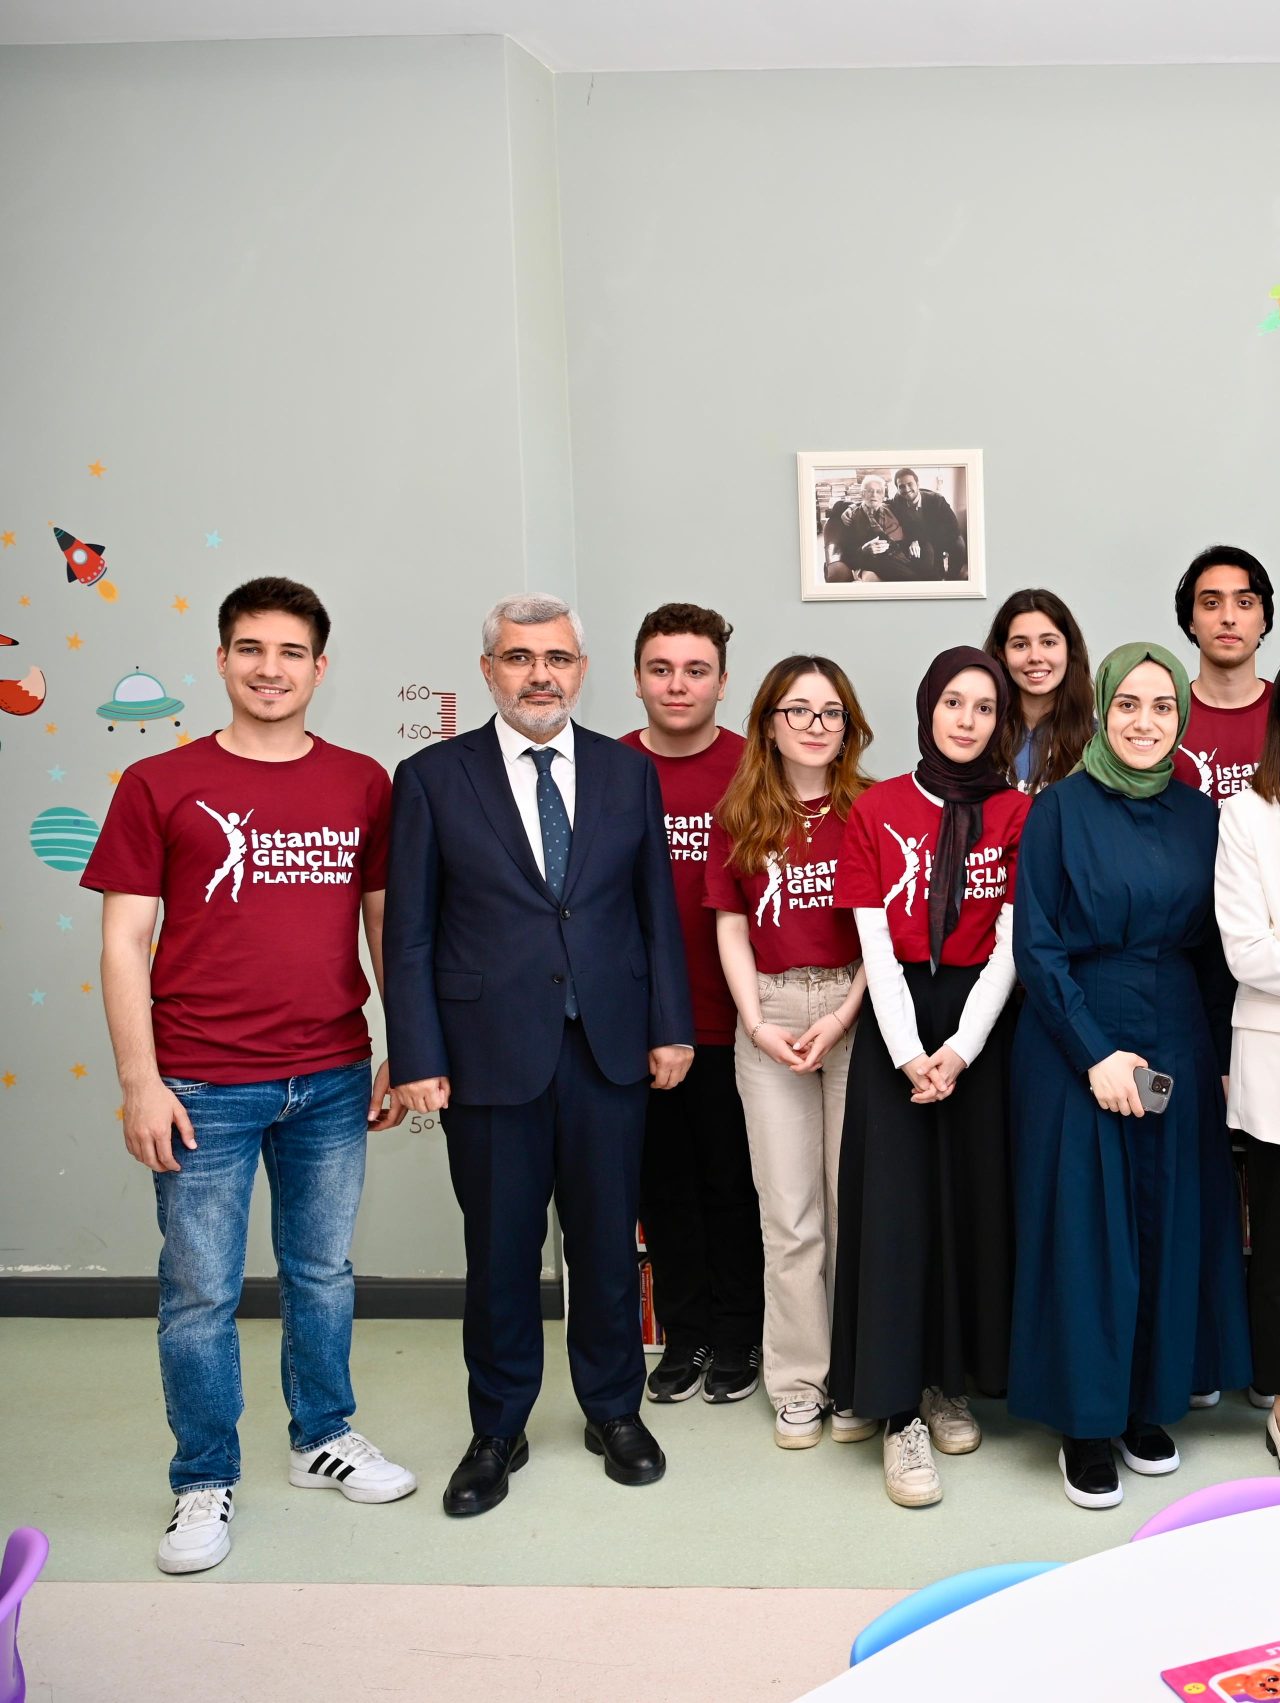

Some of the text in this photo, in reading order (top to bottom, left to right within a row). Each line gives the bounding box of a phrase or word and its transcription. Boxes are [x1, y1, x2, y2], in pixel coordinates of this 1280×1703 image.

[398, 684, 430, 702] 160
[397, 723, 432, 740] 150
[251, 827, 360, 849] istanbul
[252, 846, 356, 871] GENÇLİK
[409, 1116, 435, 1133] 50
